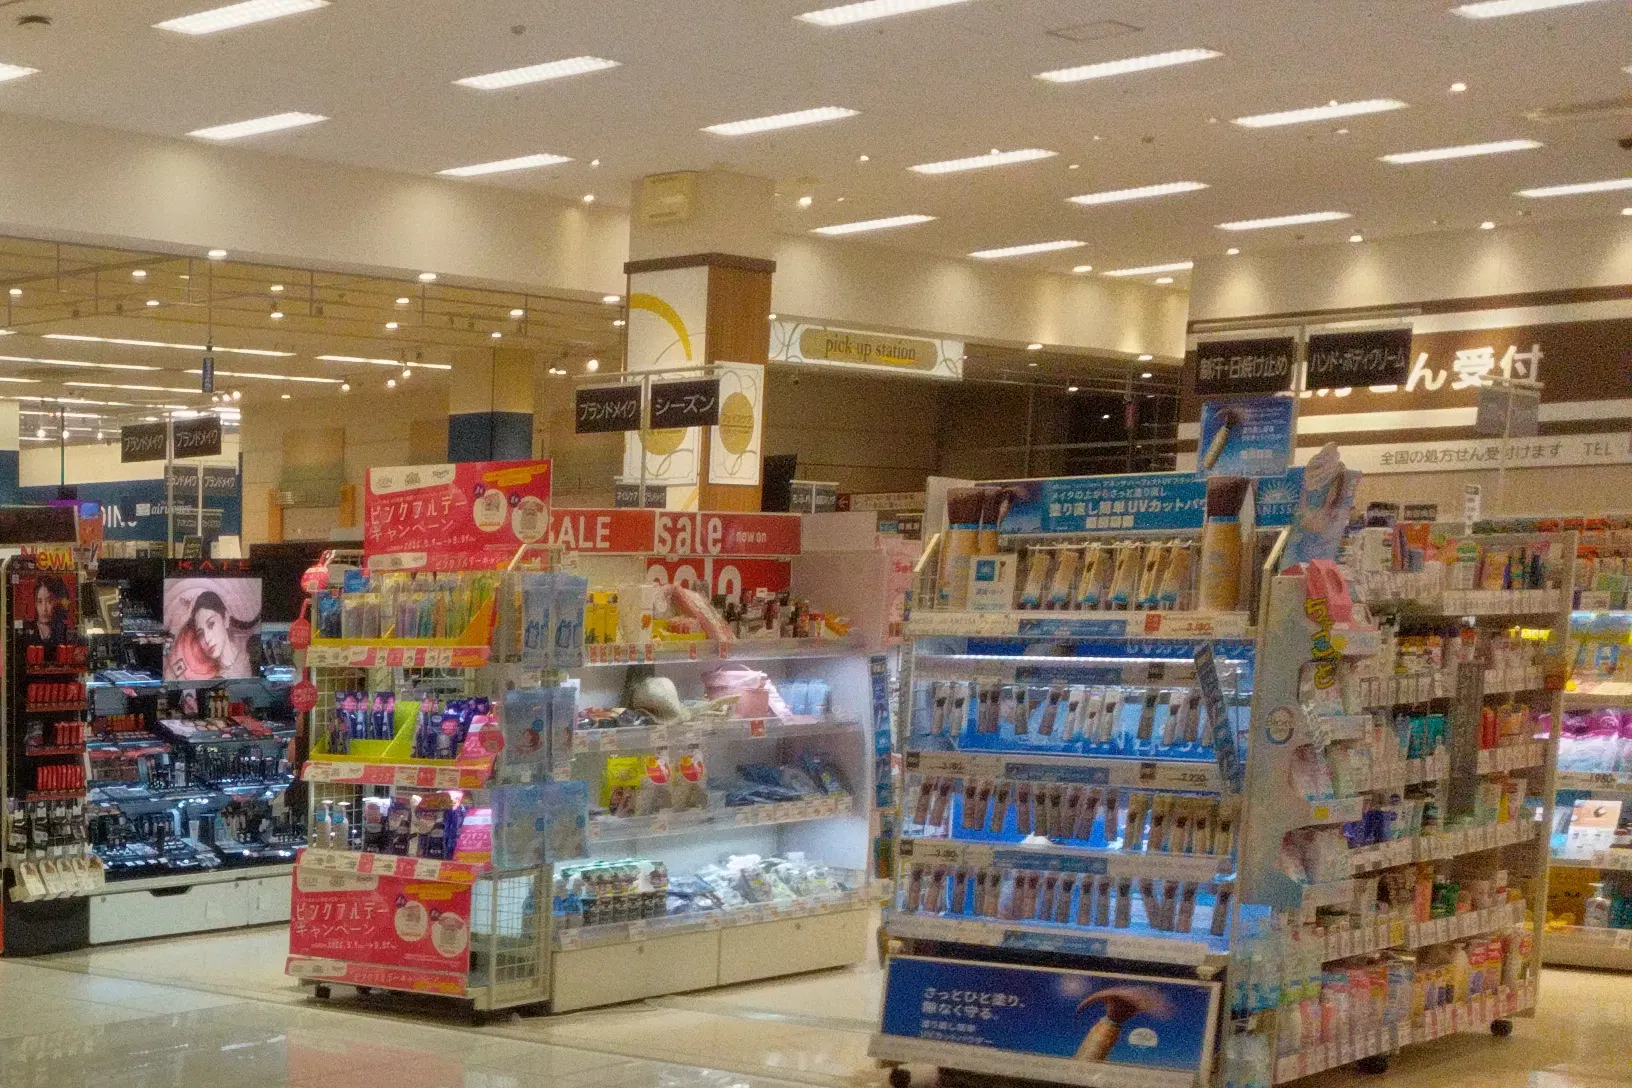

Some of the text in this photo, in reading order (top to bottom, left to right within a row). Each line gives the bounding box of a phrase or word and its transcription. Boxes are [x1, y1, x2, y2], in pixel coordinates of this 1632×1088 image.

[825, 334, 916, 361] pick up station
[580, 401, 637, 420] ブランドメイク
[655, 395, 714, 416] シーズン
[1583, 442, 1612, 456] TEL
[1257, 504, 1295, 516] NESS
[656, 514, 723, 556] sale
[20, 545, 75, 571] New!
[177, 560, 252, 571] KATE
